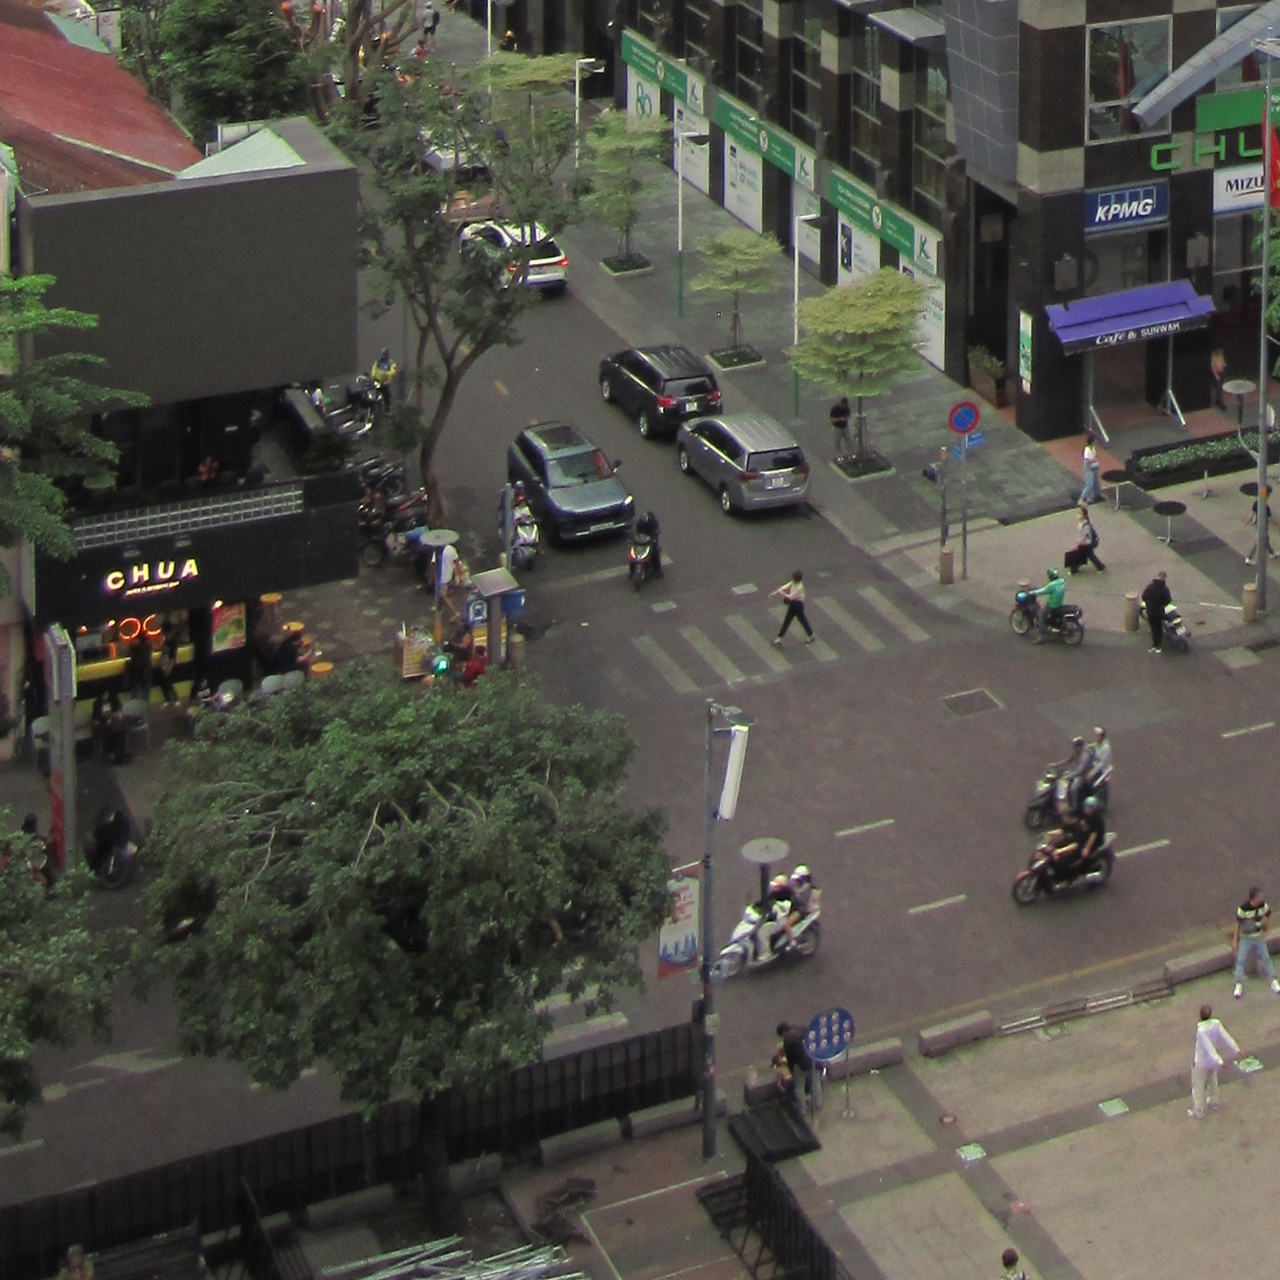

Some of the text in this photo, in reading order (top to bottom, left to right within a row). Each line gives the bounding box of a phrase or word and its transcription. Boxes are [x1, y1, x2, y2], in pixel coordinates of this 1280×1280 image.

[1225, 175, 1265, 193] MIZU
[1095, 198, 1154, 223] KPMG
[1141, 321, 1180, 338] SUNWAH
[106, 558, 199, 591] CHUA
